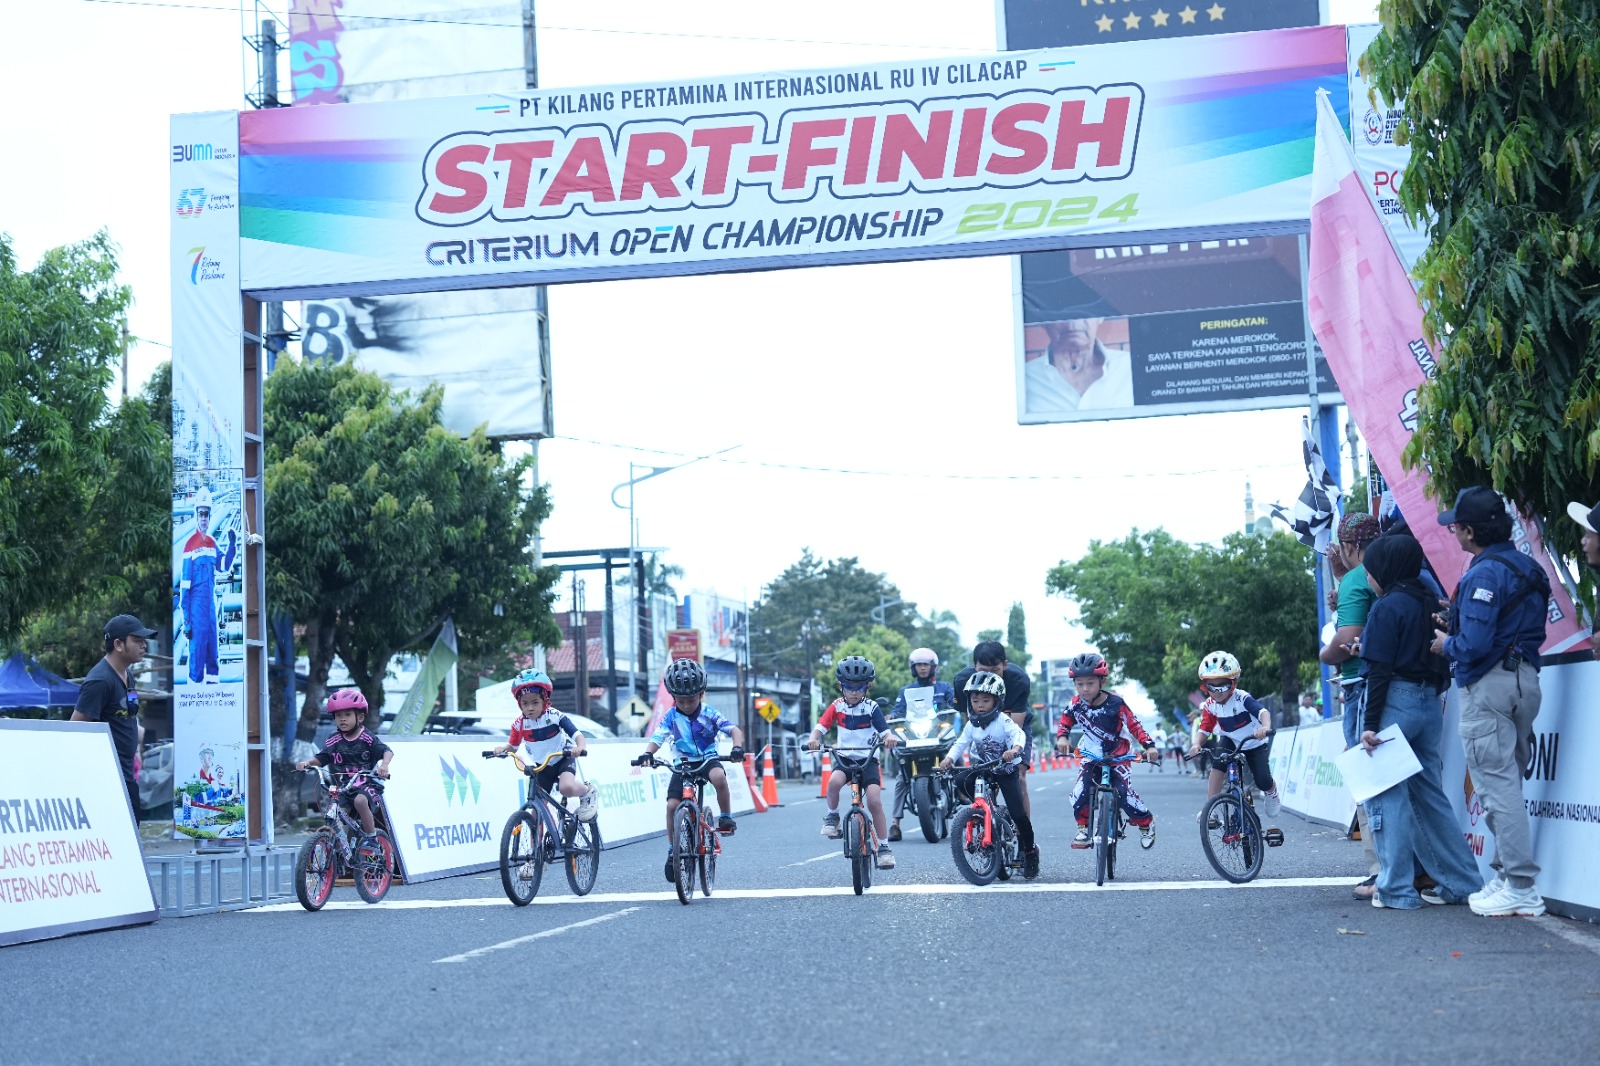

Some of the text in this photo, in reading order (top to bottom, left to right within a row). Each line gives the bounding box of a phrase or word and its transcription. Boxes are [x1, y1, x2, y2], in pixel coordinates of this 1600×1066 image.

[520, 59, 1028, 118] PT KILANG PERTAMINA INTERNASIONAL RU IV CILACAP
[428, 96, 1131, 215] START-FINISH
[425, 192, 1140, 267] CRITERIUM OPEN CHAMPIONSHIP 2024
[1200, 316, 1269, 330] PERINGATAN:
[1192, 336, 1230, 347] KARENA
[1148, 352, 1171, 362] SAYA
[1172, 348, 1214, 360] TERKENA
[1215, 345, 1253, 357] KANKER
[1145, 363, 1182, 373] LAYANAN
[1183, 359, 1225, 370] BERHENTI
[1226, 356, 1268, 366] MEROKOK
[1151, 388, 1177, 397] ORANG
[1178, 387, 1186, 395] DI
[1221, 382, 1245, 391] TAHUN
[1245, 380, 1261, 390] DAN
[1261, 377, 1305, 388] PEREMPUAN
[1166, 379, 1202, 389] DILARANG
[1202, 376, 1234, 386] MENJUAL
[1234, 375, 1250, 384] DAN
[1250, 372, 1283, 382] MEMBERI
[332, 752, 343, 764] 10
[1529, 799, 1565, 819] OLAHRAGA
[413, 821, 492, 851] PERTAMAX
[37, 838, 113, 866] PERTAMINA
